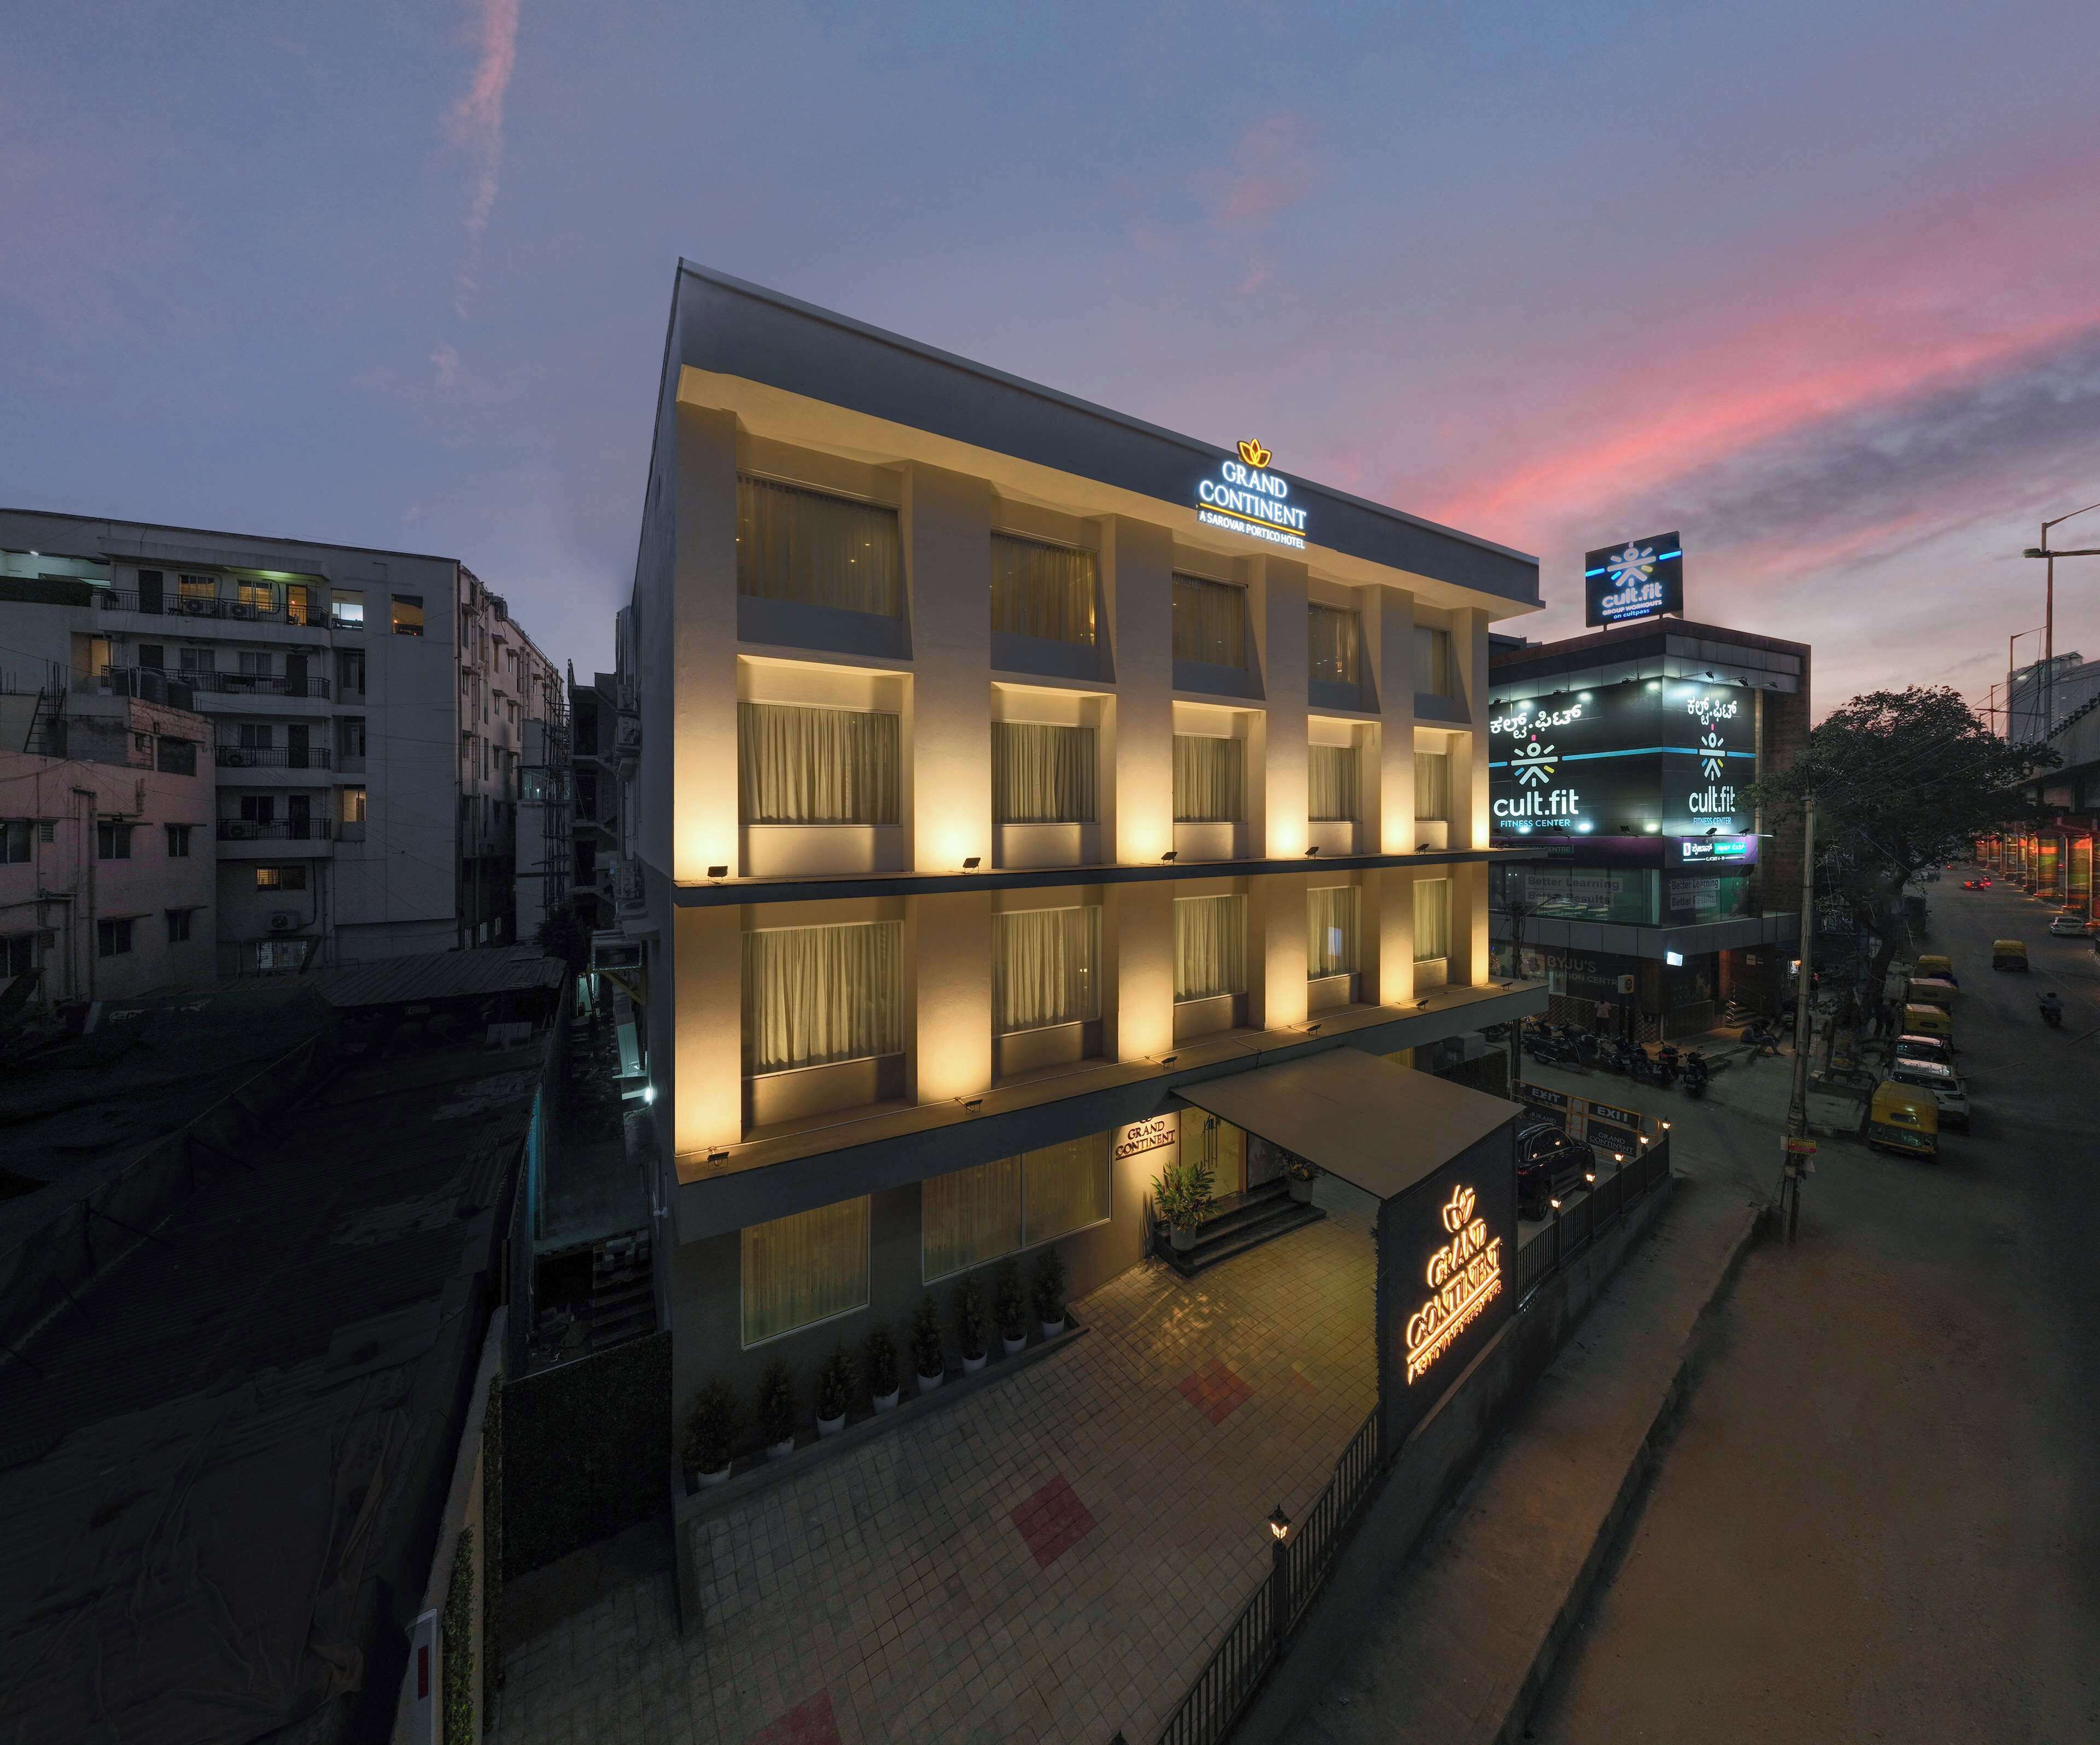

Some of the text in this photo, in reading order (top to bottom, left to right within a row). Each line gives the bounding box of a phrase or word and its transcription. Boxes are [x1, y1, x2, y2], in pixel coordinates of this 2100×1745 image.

[1222, 461, 1287, 498] GRAND
[1199, 480, 1306, 529] CONTINENT
[1199, 511, 1305, 549] A SAROVAR PORTICO HOTEL
[1602, 582, 1662, 608] cult.fit
[1602, 599, 1662, 616] GROUP WORKOUTS
[1623, 609, 1650, 617] cultpass
[1494, 789, 1579, 817] cult.fit
[1689, 786, 1736, 813] cult.fit
[1693, 817, 1731, 826] FITNESS CENTER
[1528, 877, 1620, 891] Better Learning
[1672, 878, 1719, 890] Better Learning
[1672, 896, 1691, 907] Better
[1548, 955, 1597, 973] BYJU'S
[1555, 971, 1620, 986] UITION CENTR
[1128, 1121, 1165, 1140] GRAND
[1598, 1133, 1626, 1145] GRAND
[1116, 1130, 1175, 1157] CONTINENT
[1589, 1136, 1634, 1153] CONTINENT
[1427, 1218, 1487, 1288] GRAND
[1407, 1237, 1501, 1349] CONTINENT
